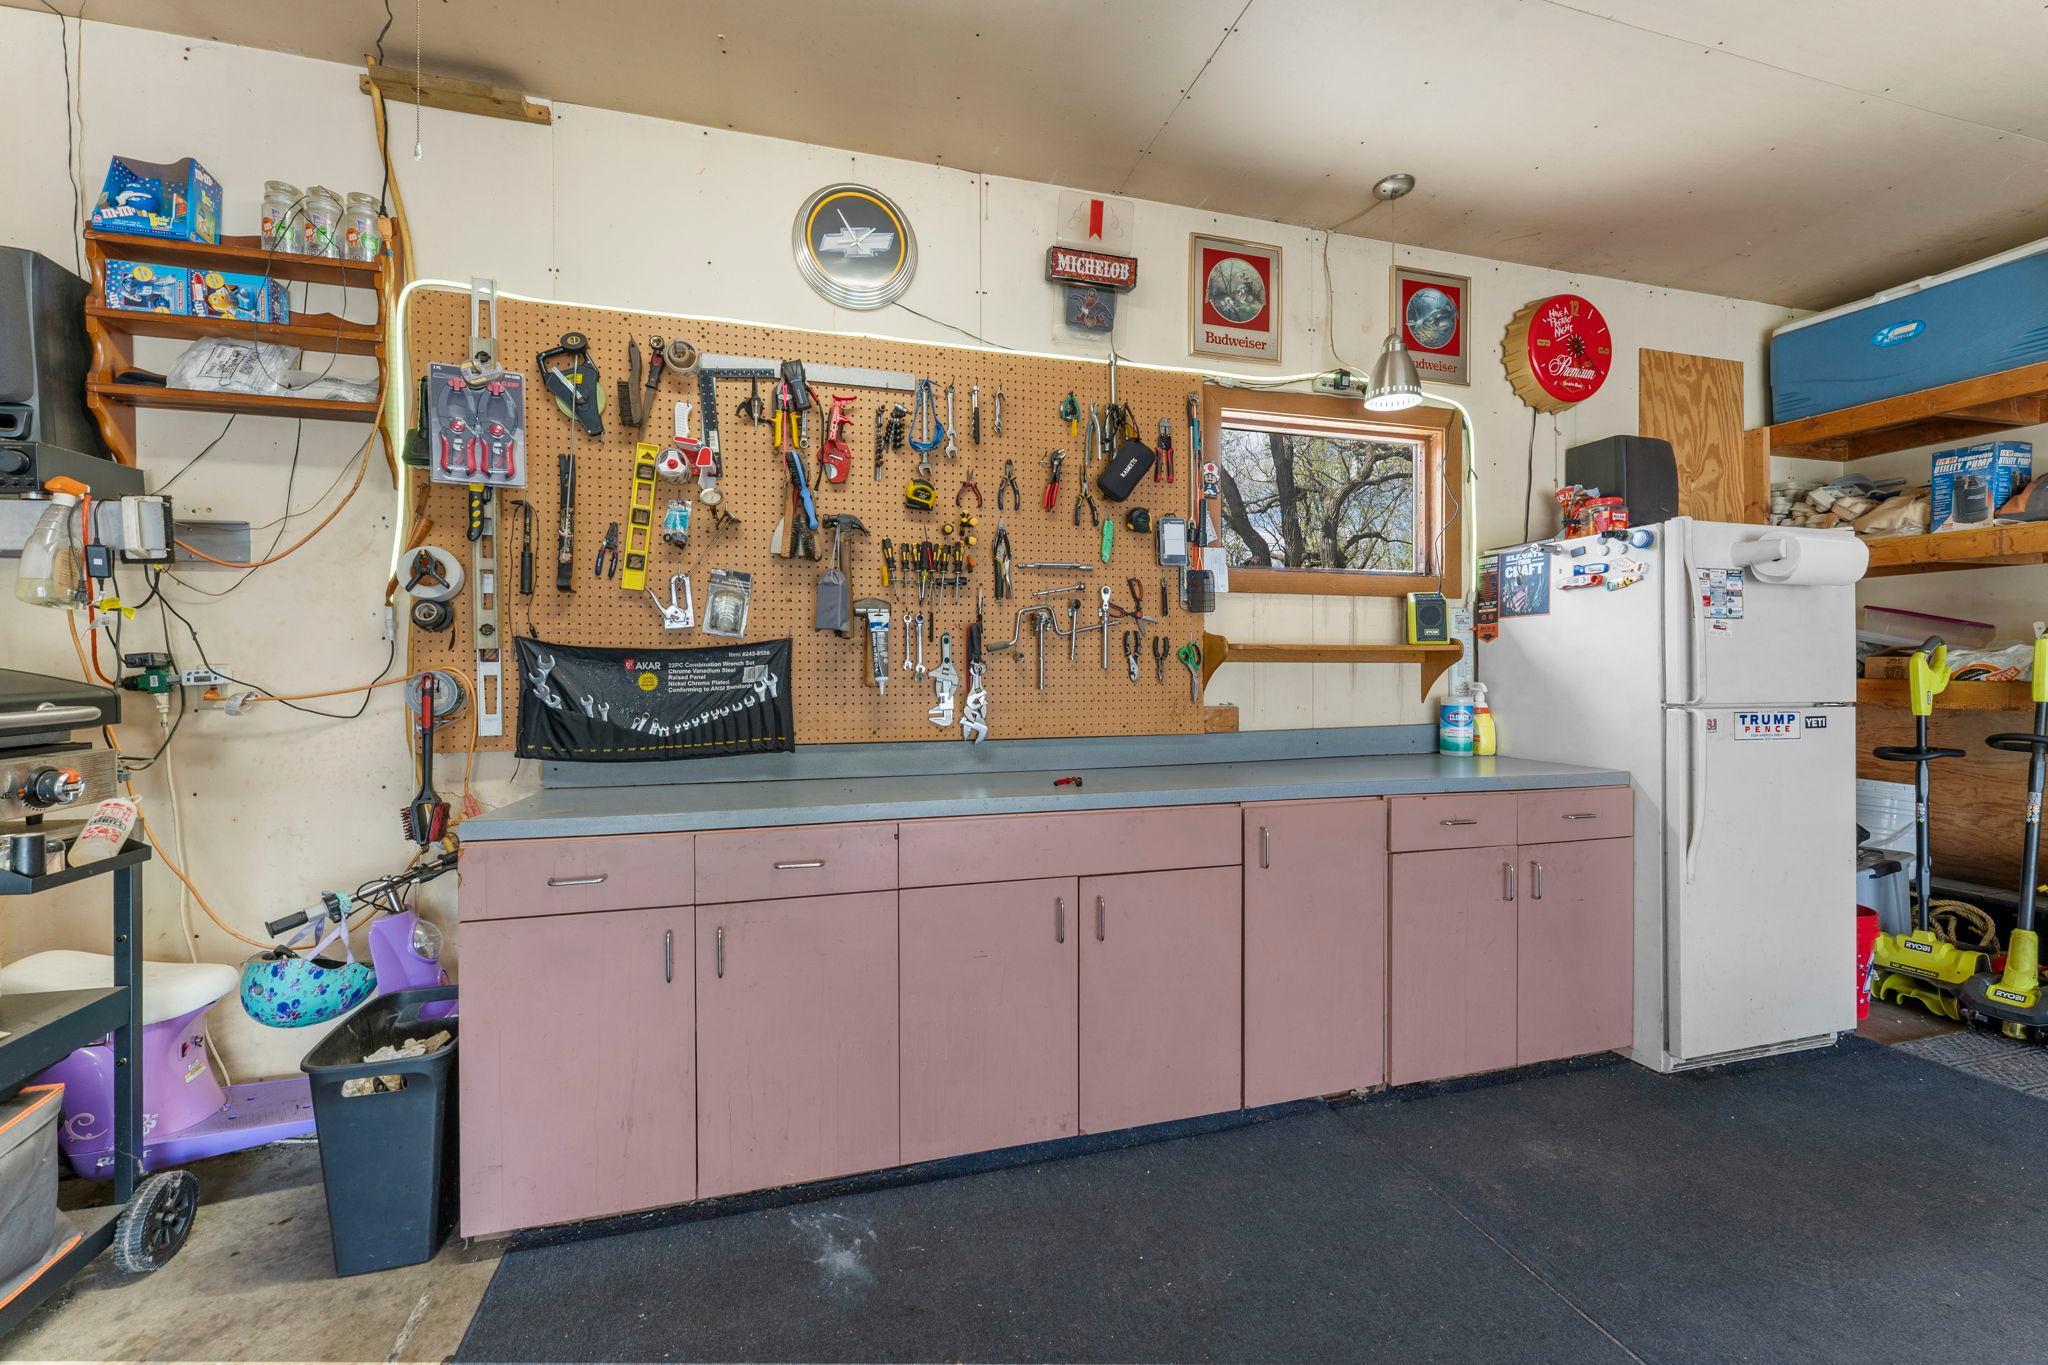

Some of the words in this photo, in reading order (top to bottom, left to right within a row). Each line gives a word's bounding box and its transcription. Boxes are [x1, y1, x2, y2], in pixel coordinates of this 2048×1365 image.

[1056, 253, 1130, 280] MICHELOB
[1570, 300, 1580, 317] 12
[1205, 331, 1267, 350] Budweiser
[1413, 357, 1458, 373] udweiser
[1548, 354, 1597, 380] Premium
[1934, 462, 1964, 474] UTILITY
[1965, 458, 1993, 469] PUMP
[1505, 562, 1544, 579] CRAFT
[635, 661, 661, 670] AKAR
[1740, 714, 1796, 725] TRUMP
[1805, 717, 1826, 727] YETI
[1744, 725, 1791, 733] PENCE
[1906, 941, 1931, 952] RYOBI
[1995, 990, 2025, 1002] RYOBI
